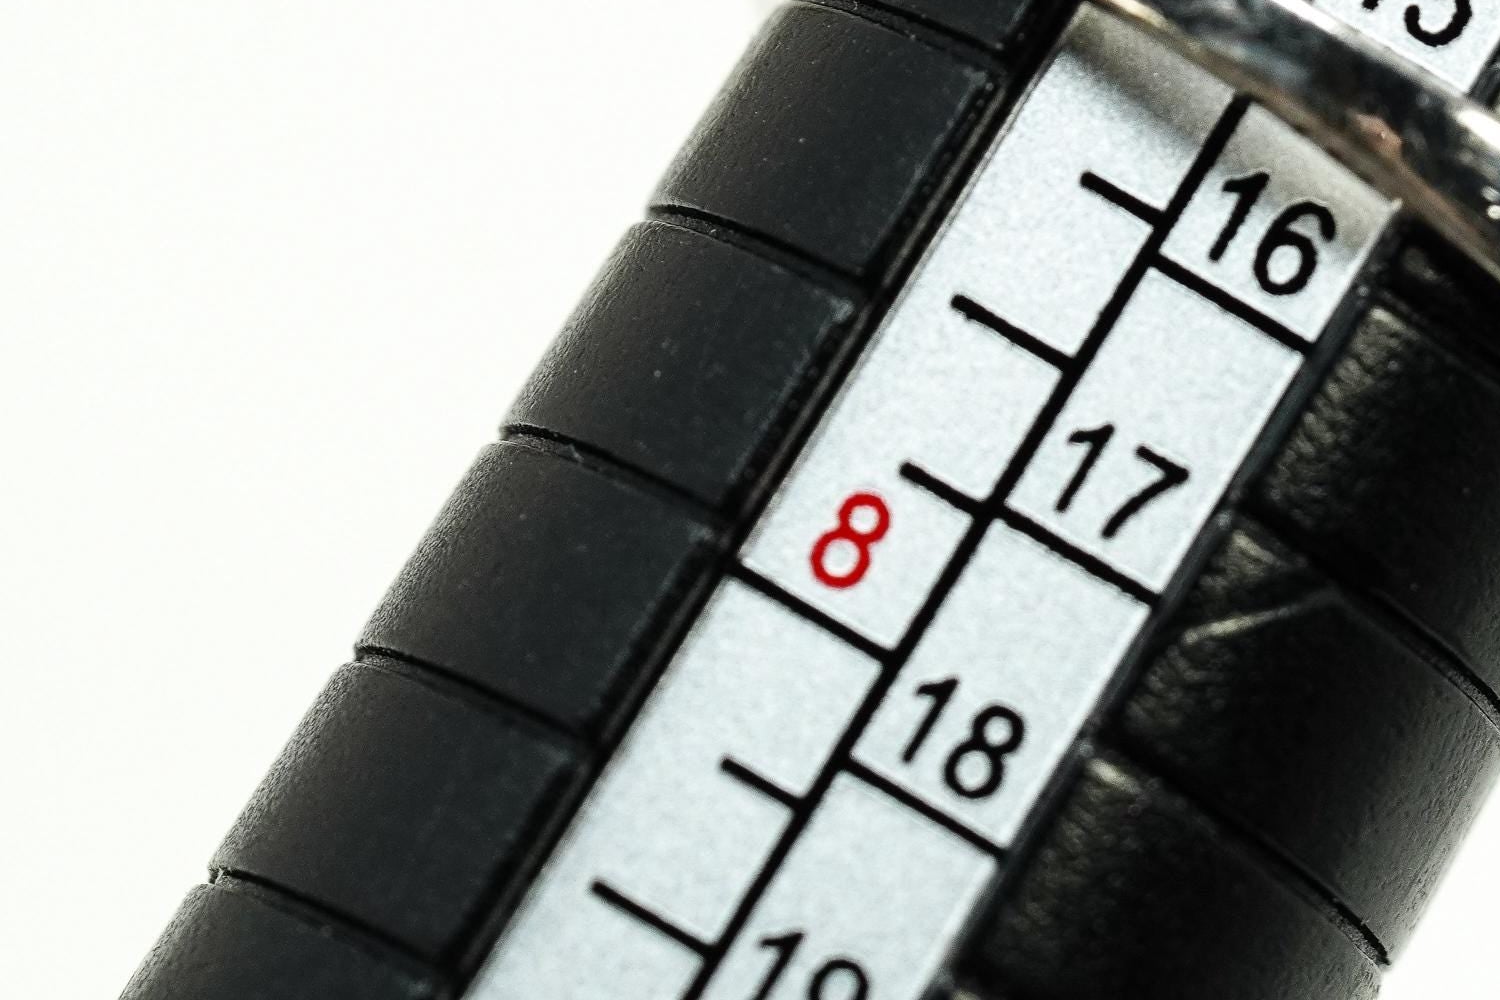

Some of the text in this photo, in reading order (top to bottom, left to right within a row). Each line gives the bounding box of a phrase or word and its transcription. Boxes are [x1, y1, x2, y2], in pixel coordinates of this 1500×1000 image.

[1208, 170, 1339, 297] 16
[809, 491, 892, 590] 8
[1054, 423, 1191, 540] 17
[901, 676, 1026, 801] 18
